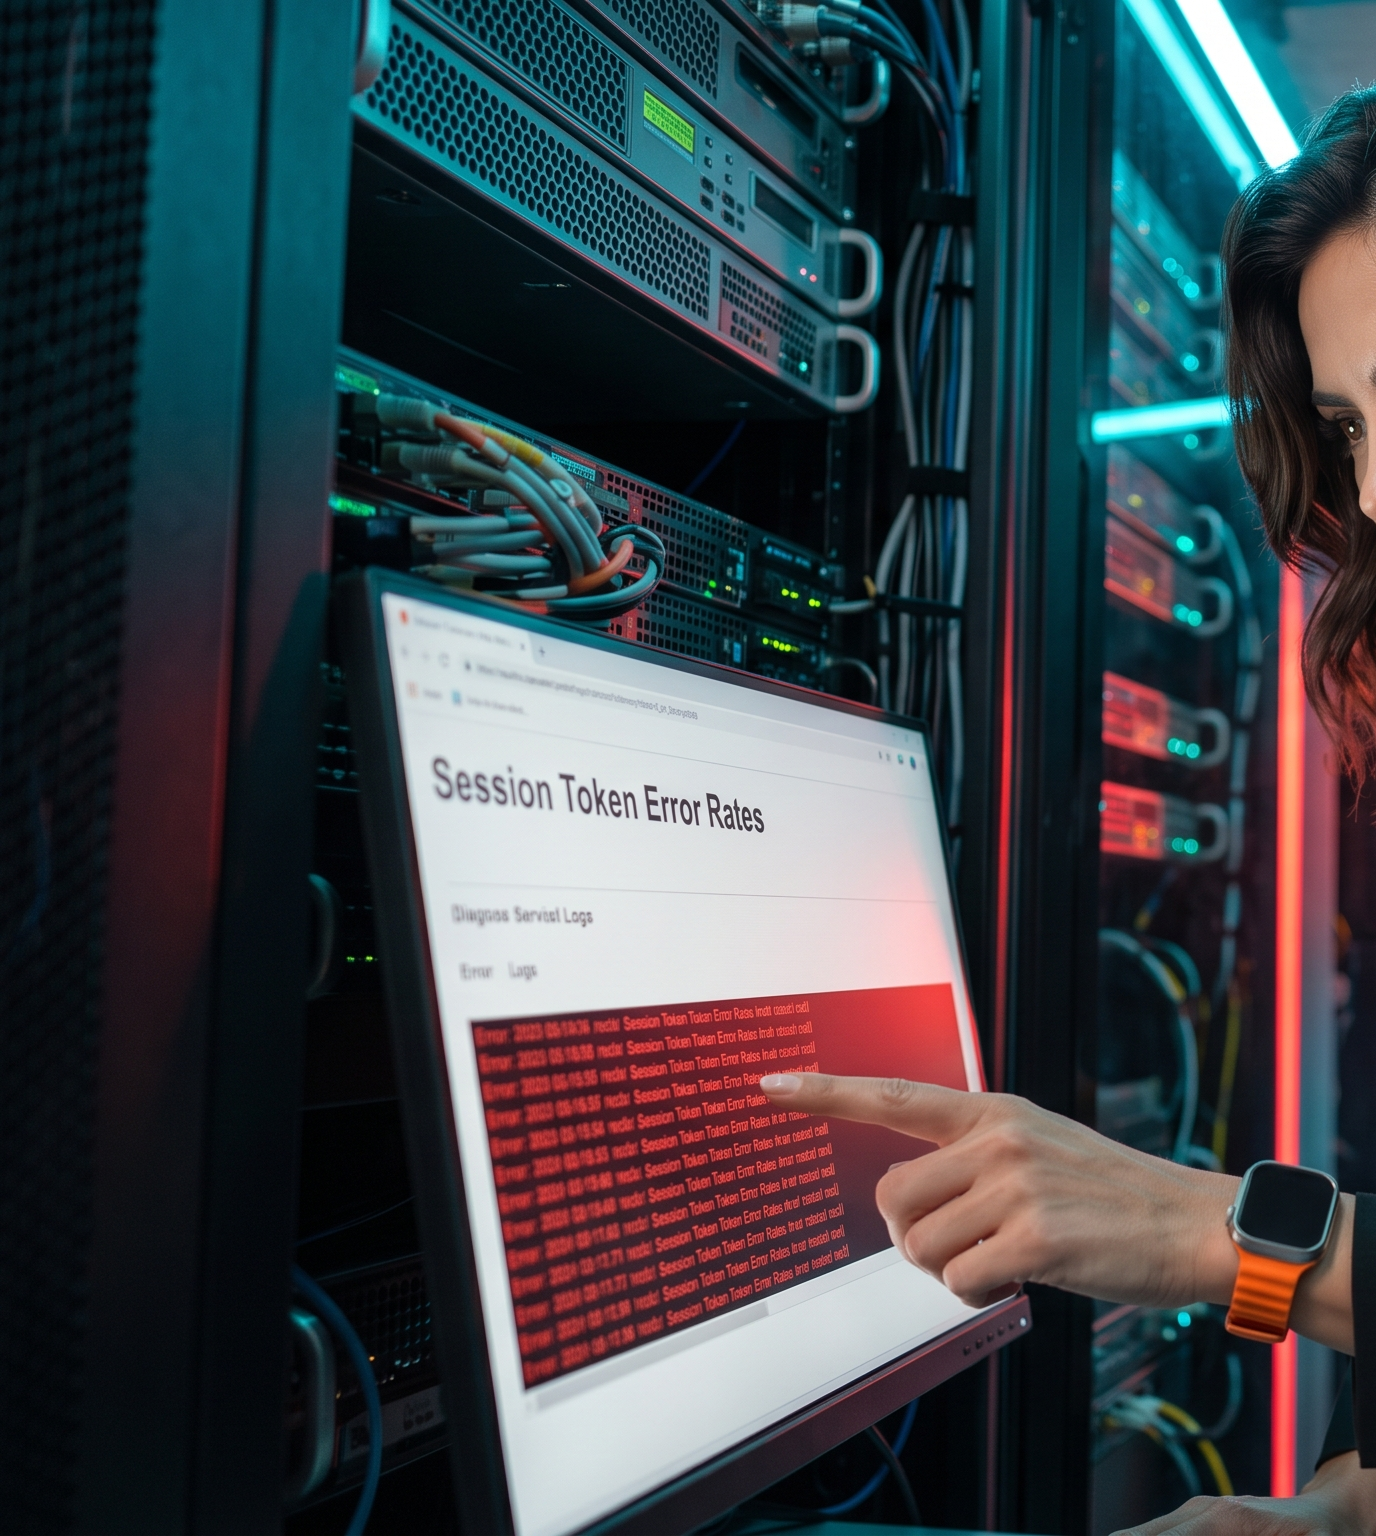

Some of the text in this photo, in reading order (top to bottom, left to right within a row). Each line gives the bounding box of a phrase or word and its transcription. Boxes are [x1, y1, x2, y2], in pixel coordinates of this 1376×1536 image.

[433, 756, 765, 833] Session Token Error Rates
